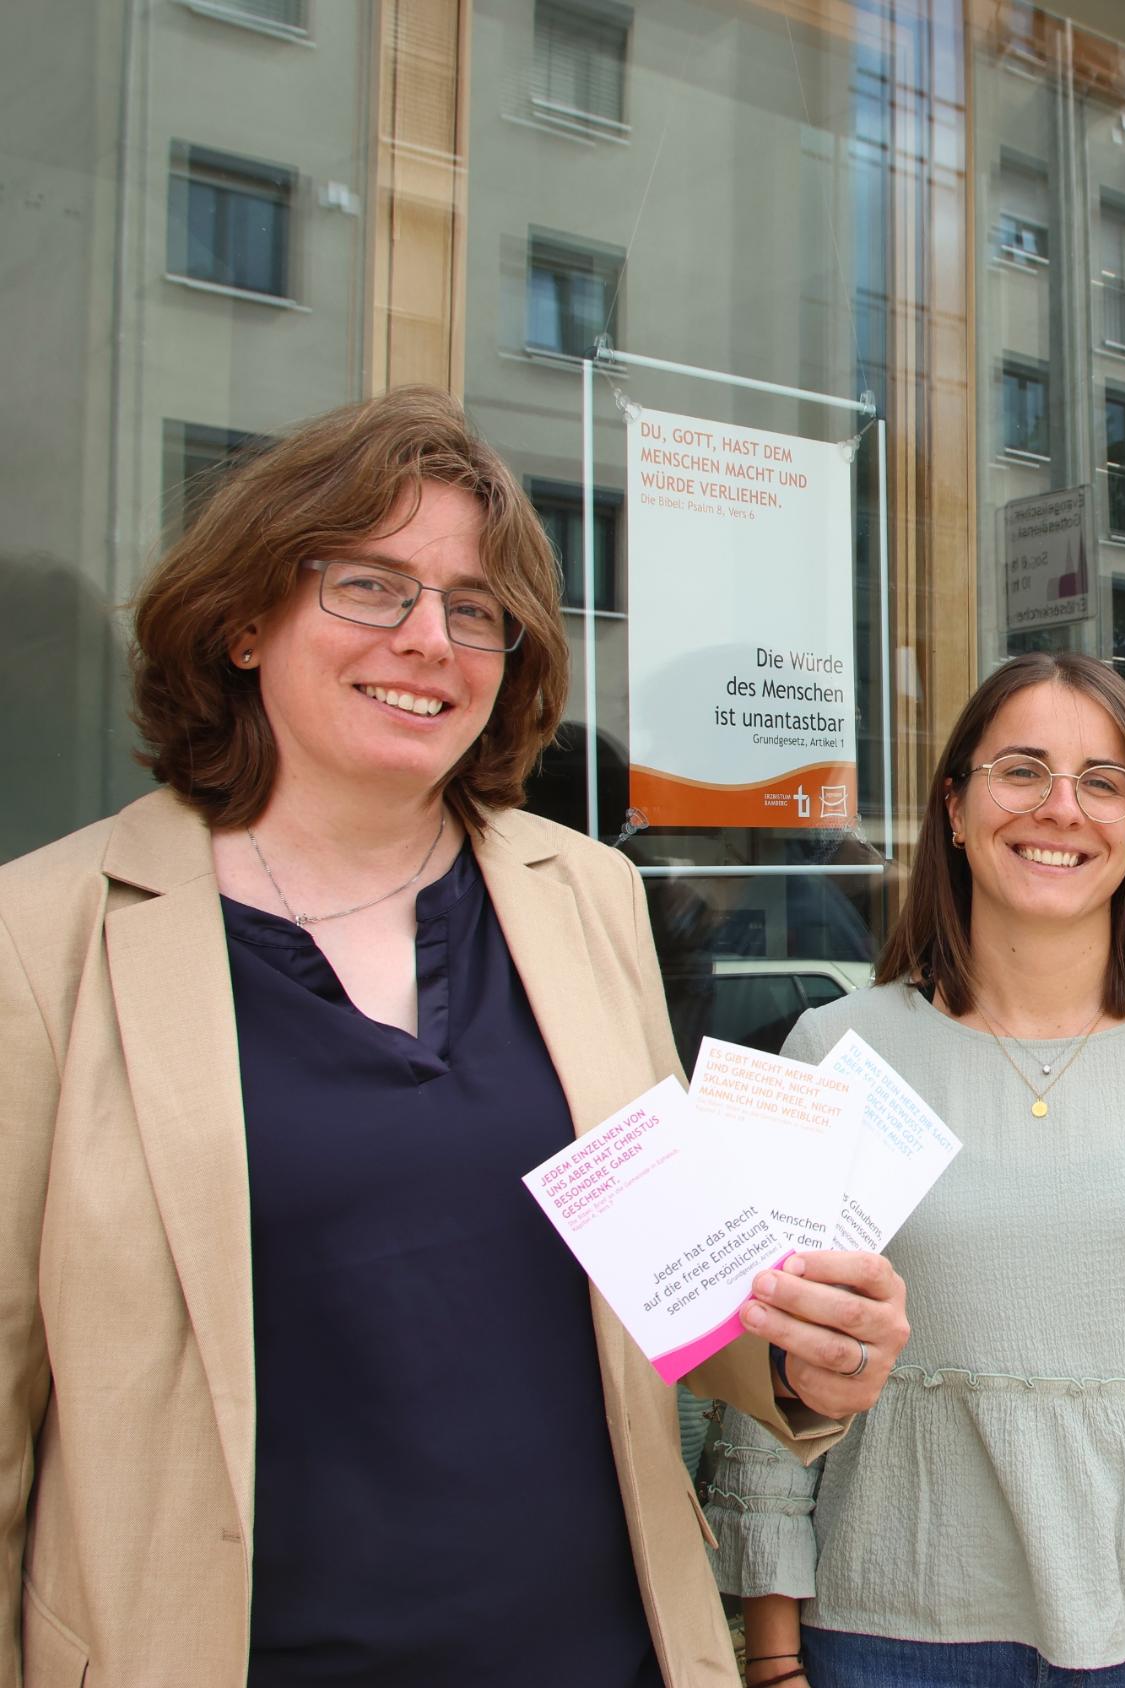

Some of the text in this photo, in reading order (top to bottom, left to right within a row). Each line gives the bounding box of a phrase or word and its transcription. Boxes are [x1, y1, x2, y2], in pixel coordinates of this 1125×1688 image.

[641, 422, 792, 462] DU, GOTT, HAST DEM
[641, 448, 807, 488] MENSCHEN MACHT UND
[641, 471, 783, 507] WÜRDE VERLIEHEN.
[641, 493, 756, 521] Die Bibel: Psalm 8, Vers 6
[757, 648, 843, 673] Die Würde
[727, 676, 843, 702] des Menschen
[715, 706, 843, 731] ist unantastbar
[753, 733, 845, 749] Grundgesetz, Artikel 1
[707, 1059, 821, 1097] UND GRIECHEN, NICHT
[709, 1047, 849, 1092] ES GIBT NICHT MEHR JUDEN
[704, 1073, 841, 1116] SKLAVEN UND FREIE, NICHT
[757, 1099, 778, 1113] UND
[782, 1108, 830, 1127] WEIBLICH.
[542, 1110, 645, 1186] JEDEM EINZELNEN VON
[545, 1116, 659, 1197] UNS ABER HAT CHRISTUS
[554, 1144, 642, 1208] BESONDERE GABEN
[562, 1177, 615, 1218] GESCHENKT.
[771, 1210, 826, 1232] Menschen
[841, 1209, 877, 1250] Gewissens
[850, 1200, 882, 1241] Glaubens,
[654, 1207, 758, 1284] Jeder hat das Recht
[797, 1234, 822, 1248] dem
[644, 1220, 768, 1311] auf die freie Entfaltung
[667, 1234, 776, 1315] seiner Persönlichkeit
